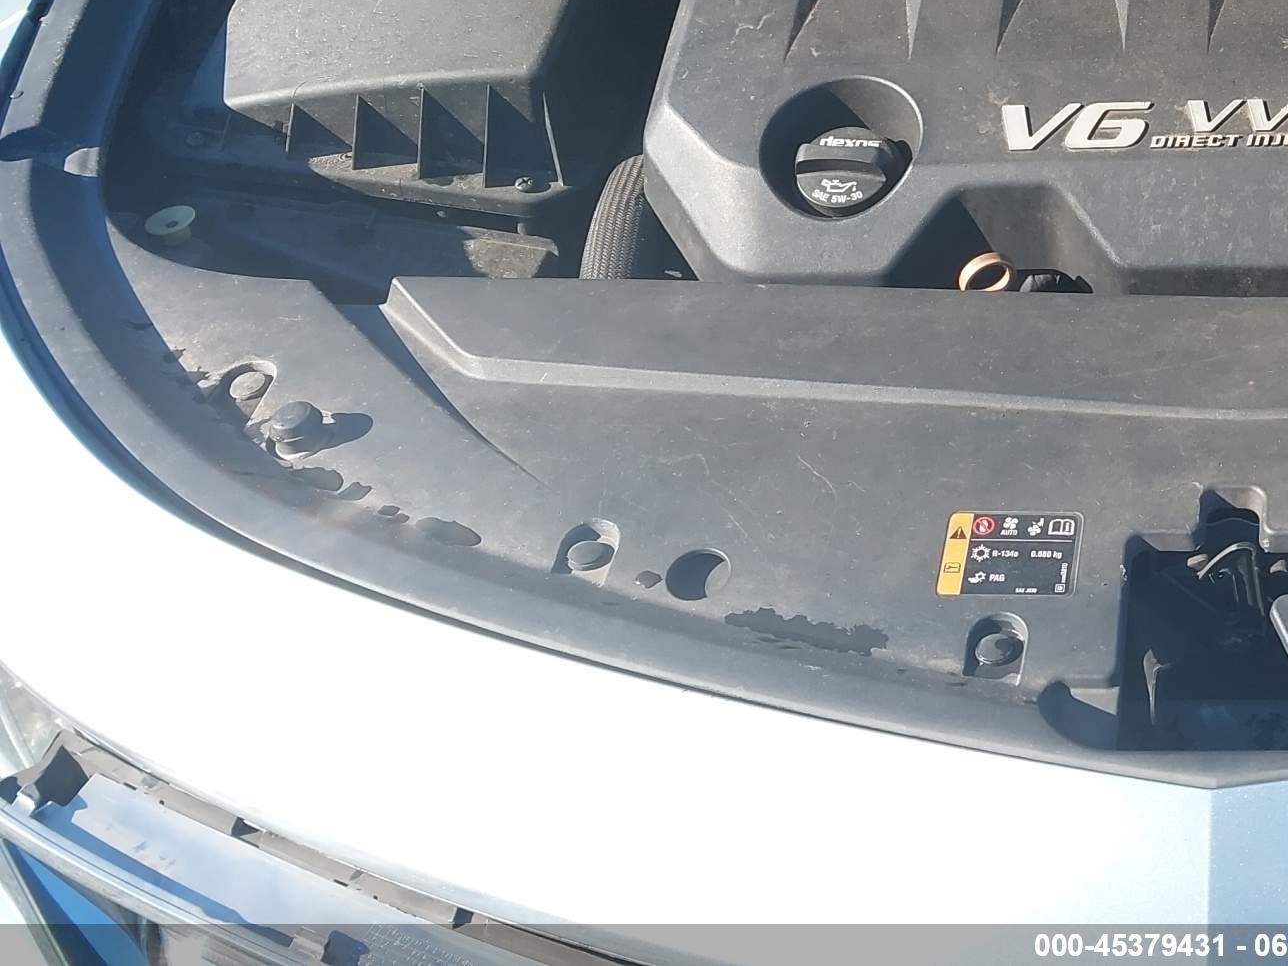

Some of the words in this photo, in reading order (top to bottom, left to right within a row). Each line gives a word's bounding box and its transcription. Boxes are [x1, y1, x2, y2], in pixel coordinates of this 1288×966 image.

[1001, 100, 1153, 151] V6
[1149, 132, 1244, 149] DIRECT
[812, 189, 829, 202] SAE
[831, 191, 863, 203] 5W-30
[1053, 551, 1063, 559] kg
[989, 573, 1006, 582] PAG
